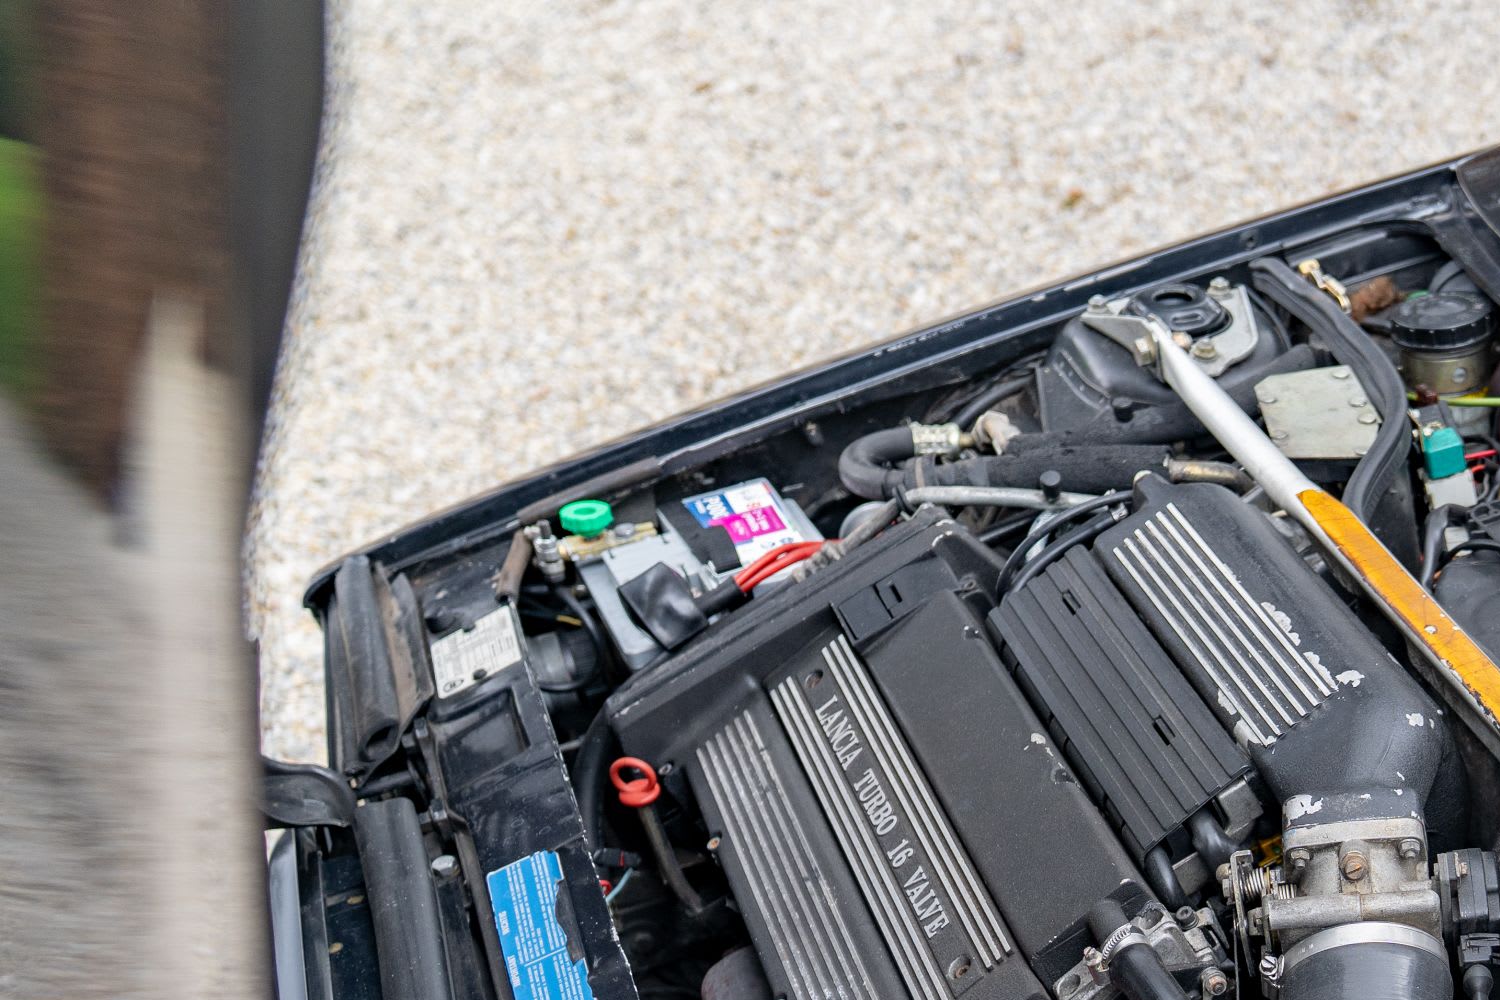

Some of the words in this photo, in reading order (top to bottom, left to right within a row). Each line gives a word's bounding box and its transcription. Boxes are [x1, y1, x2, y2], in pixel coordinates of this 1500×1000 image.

[815, 694, 863, 771] LANCIA
[854, 767, 898, 836] TURBO
[887, 838, 913, 868] 16
[903, 865, 950, 939] VALVE
